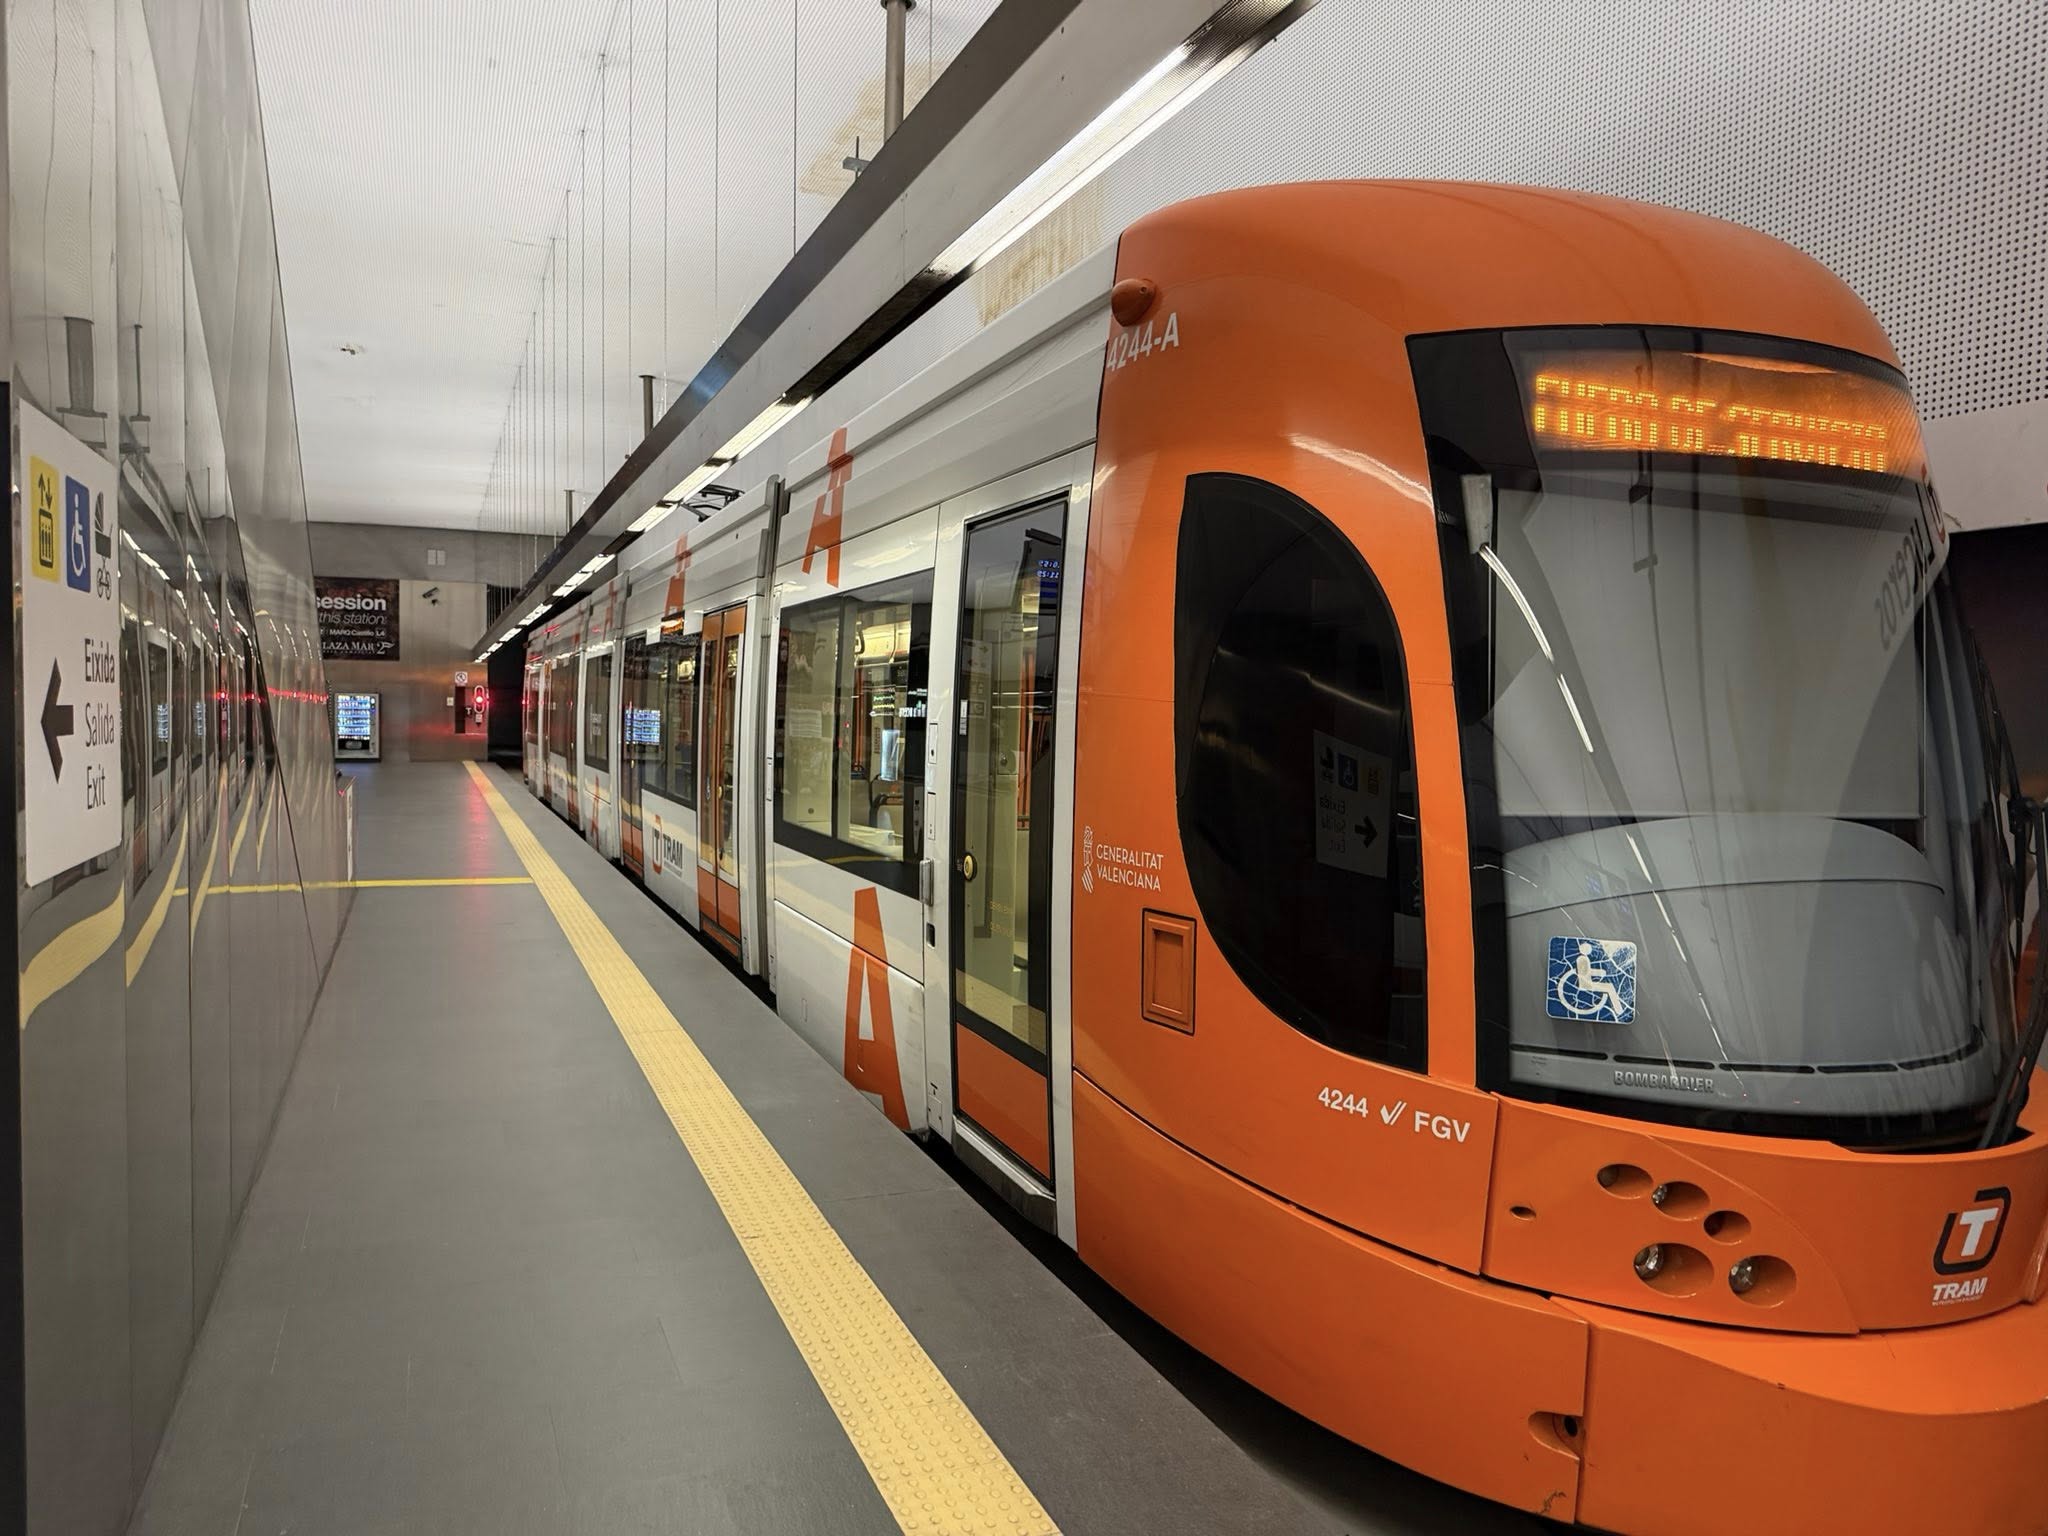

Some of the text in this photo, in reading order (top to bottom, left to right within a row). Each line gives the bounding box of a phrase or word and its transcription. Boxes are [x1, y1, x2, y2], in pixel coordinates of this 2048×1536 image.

[1105, 312, 1180, 372] 4244-A
[319, 611, 341, 624] this
[84, 637, 116, 684] Eixida
[85, 703, 115, 748] Salida
[86, 765, 106, 810] Exit
[663, 833, 683, 869] TRAM
[1096, 864, 1162, 892] VALENCIANA
[1614, 1070, 1715, 1094] BOMBARDIER
[1318, 1086, 1471, 1143] 4244 FGV
[1932, 1277, 1988, 1301] TRAM
